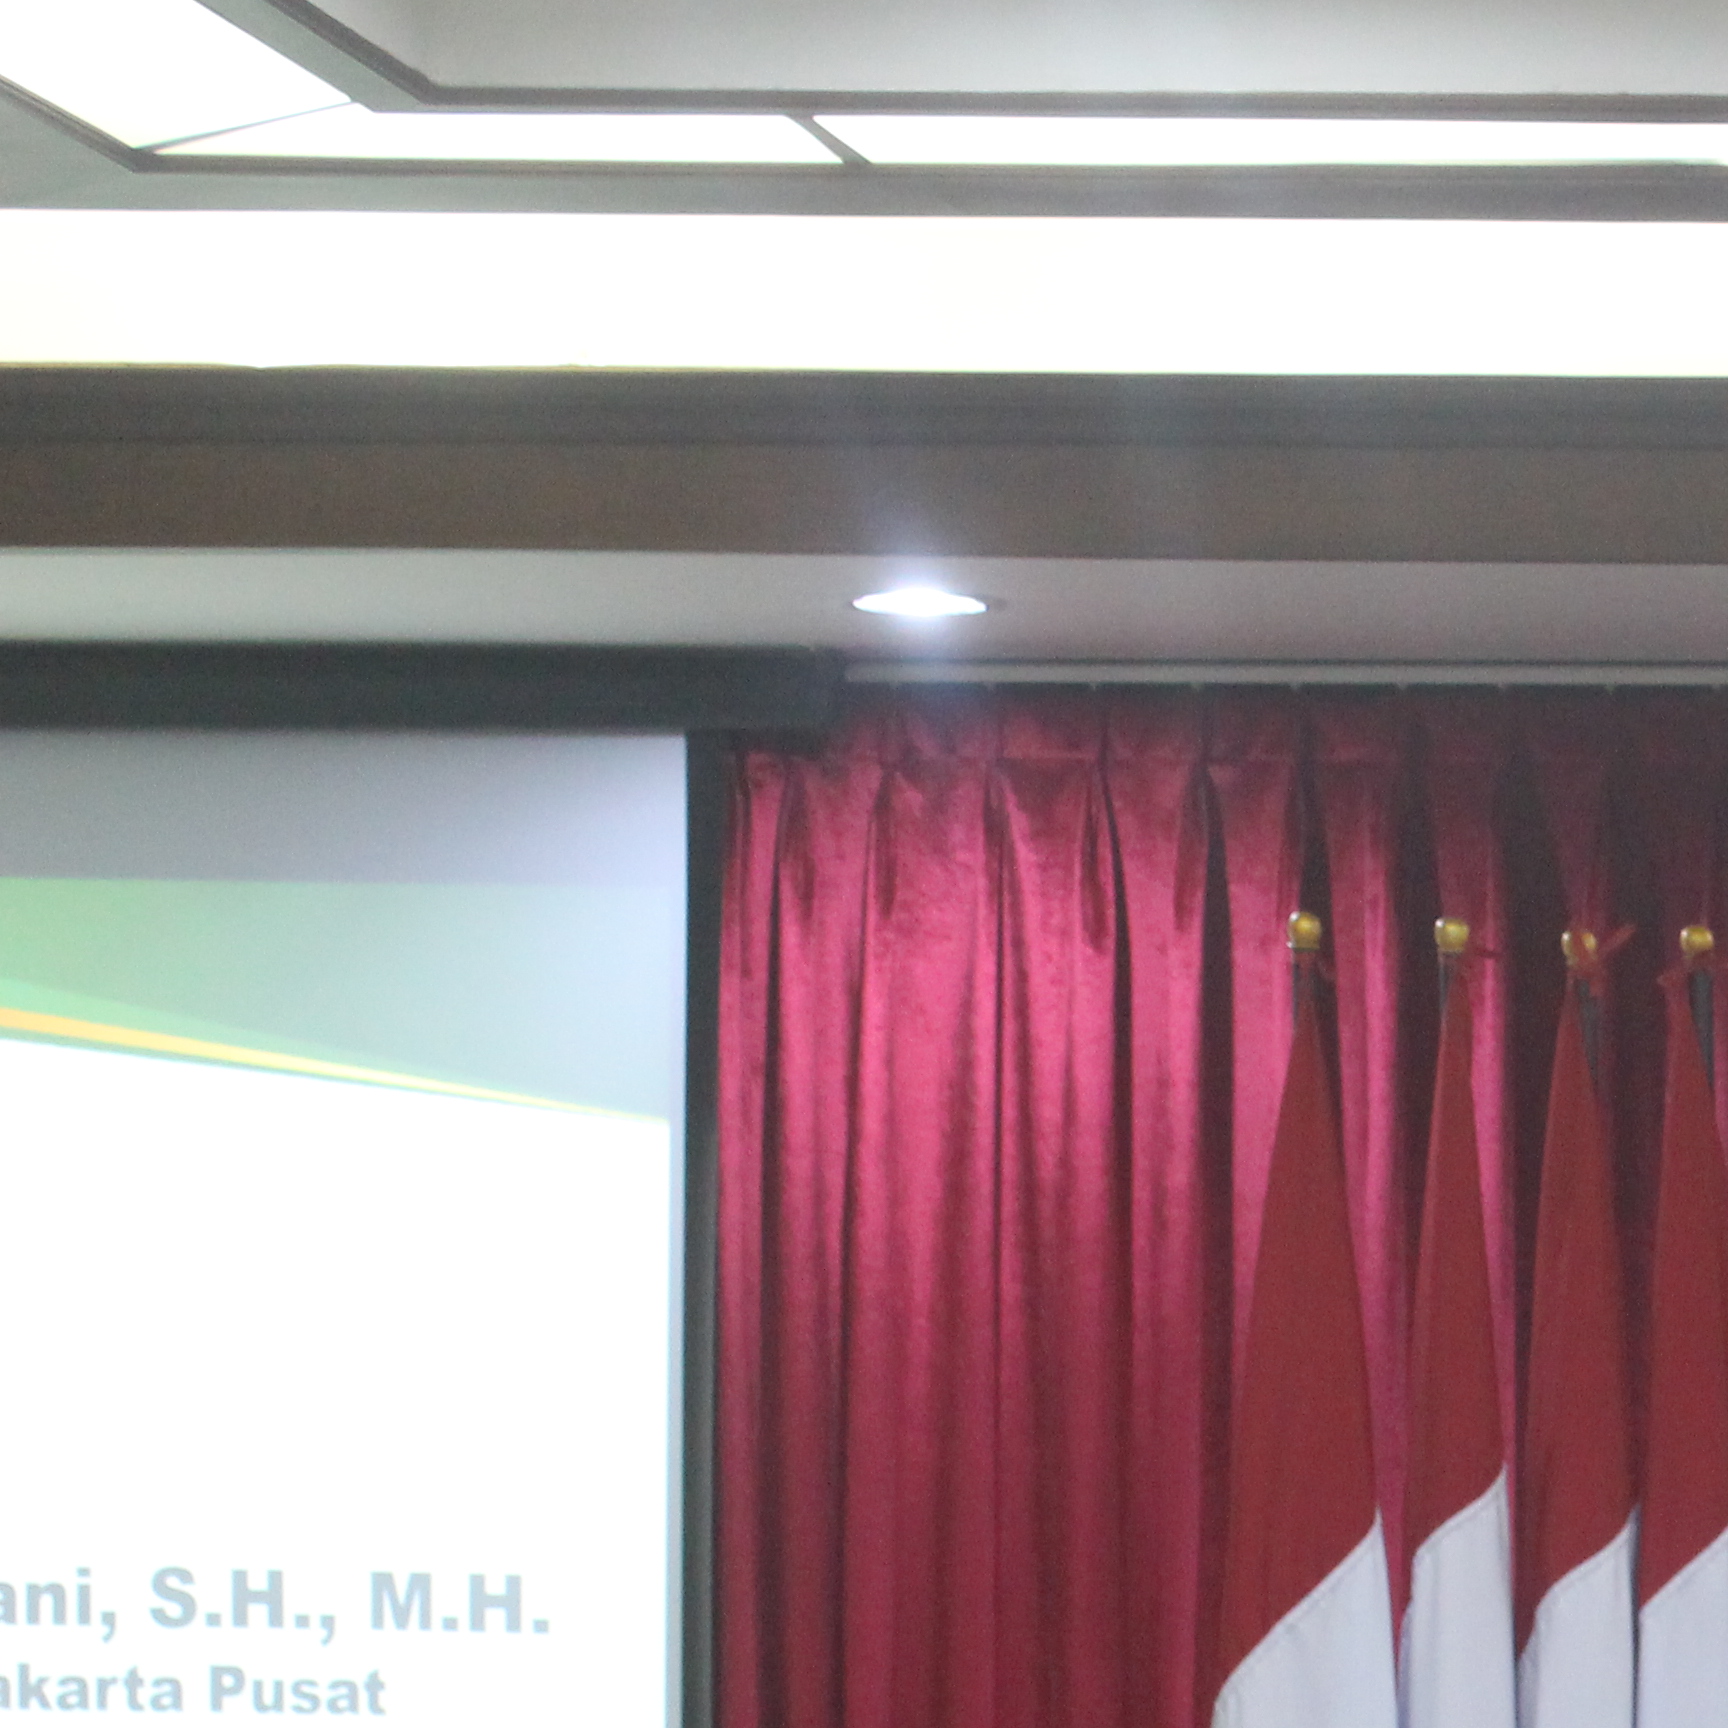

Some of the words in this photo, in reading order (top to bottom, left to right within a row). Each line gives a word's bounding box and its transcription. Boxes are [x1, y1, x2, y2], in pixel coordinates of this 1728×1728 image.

[149, 1566, 335, 1646] S.H.,
[370, 1570, 549, 1634] M.H.
[209, 1663, 385, 1716] Pusat
